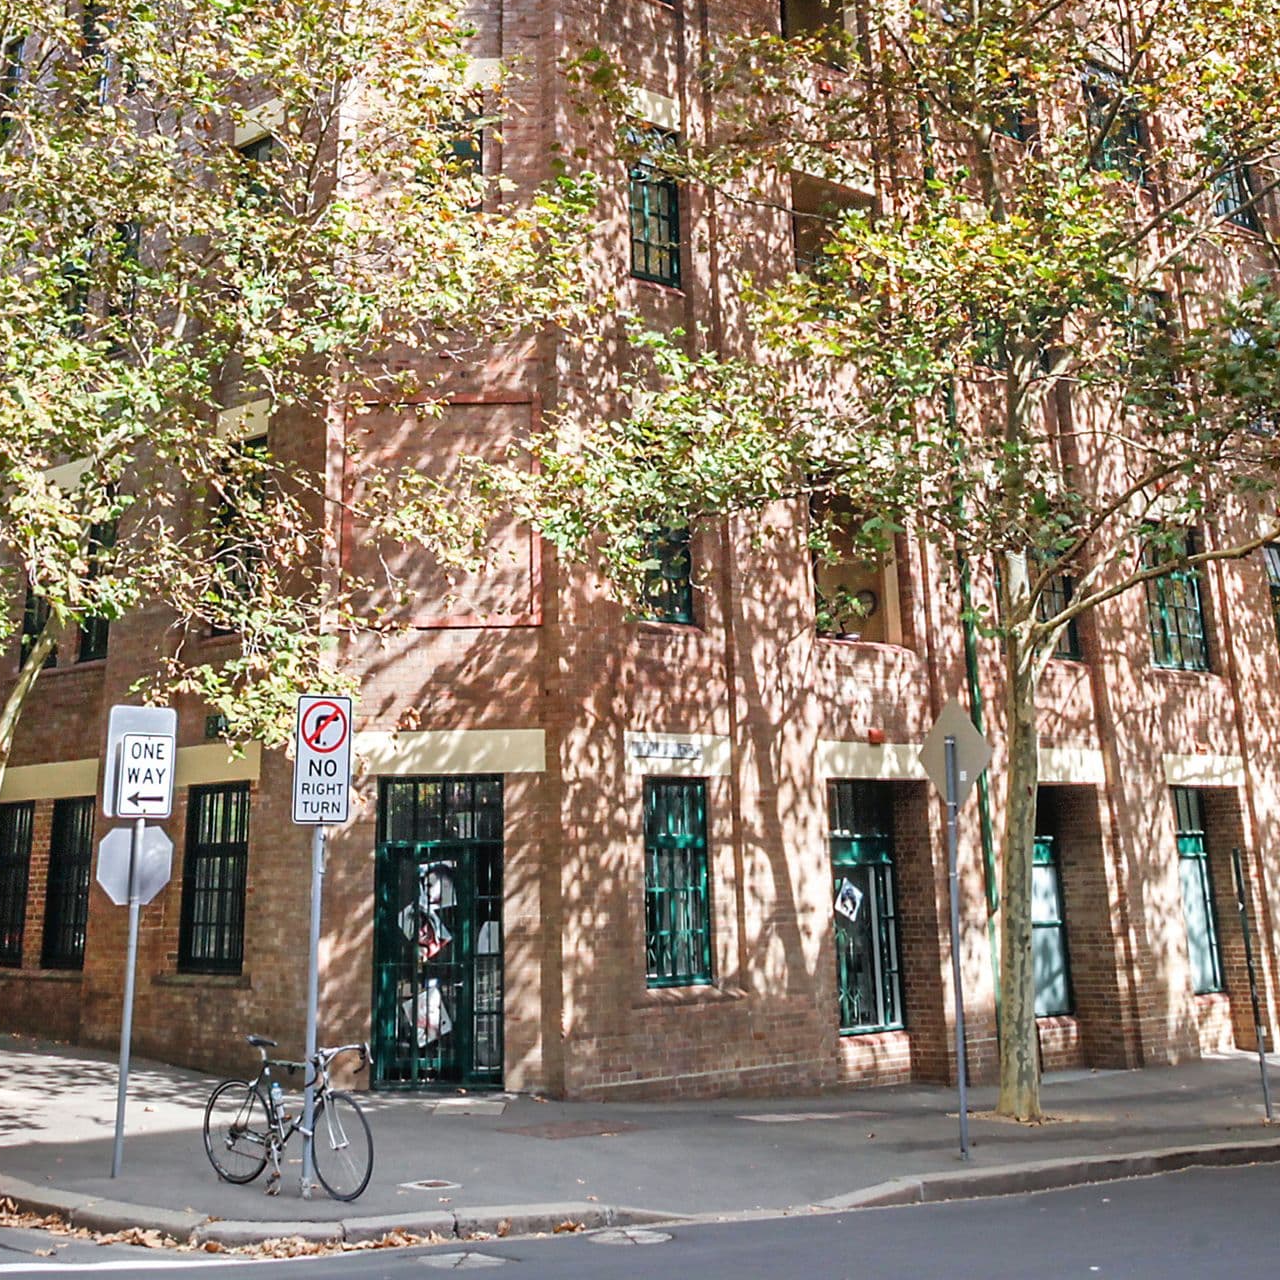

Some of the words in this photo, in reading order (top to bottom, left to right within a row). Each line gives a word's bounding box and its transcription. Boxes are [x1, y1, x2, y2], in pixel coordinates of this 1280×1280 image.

[131, 742, 165, 760] ONE
[127, 767, 166, 784] WAY
[308, 759, 337, 777] NO
[301, 782, 343, 795] RIGHT
[302, 801, 341, 814] TURN
